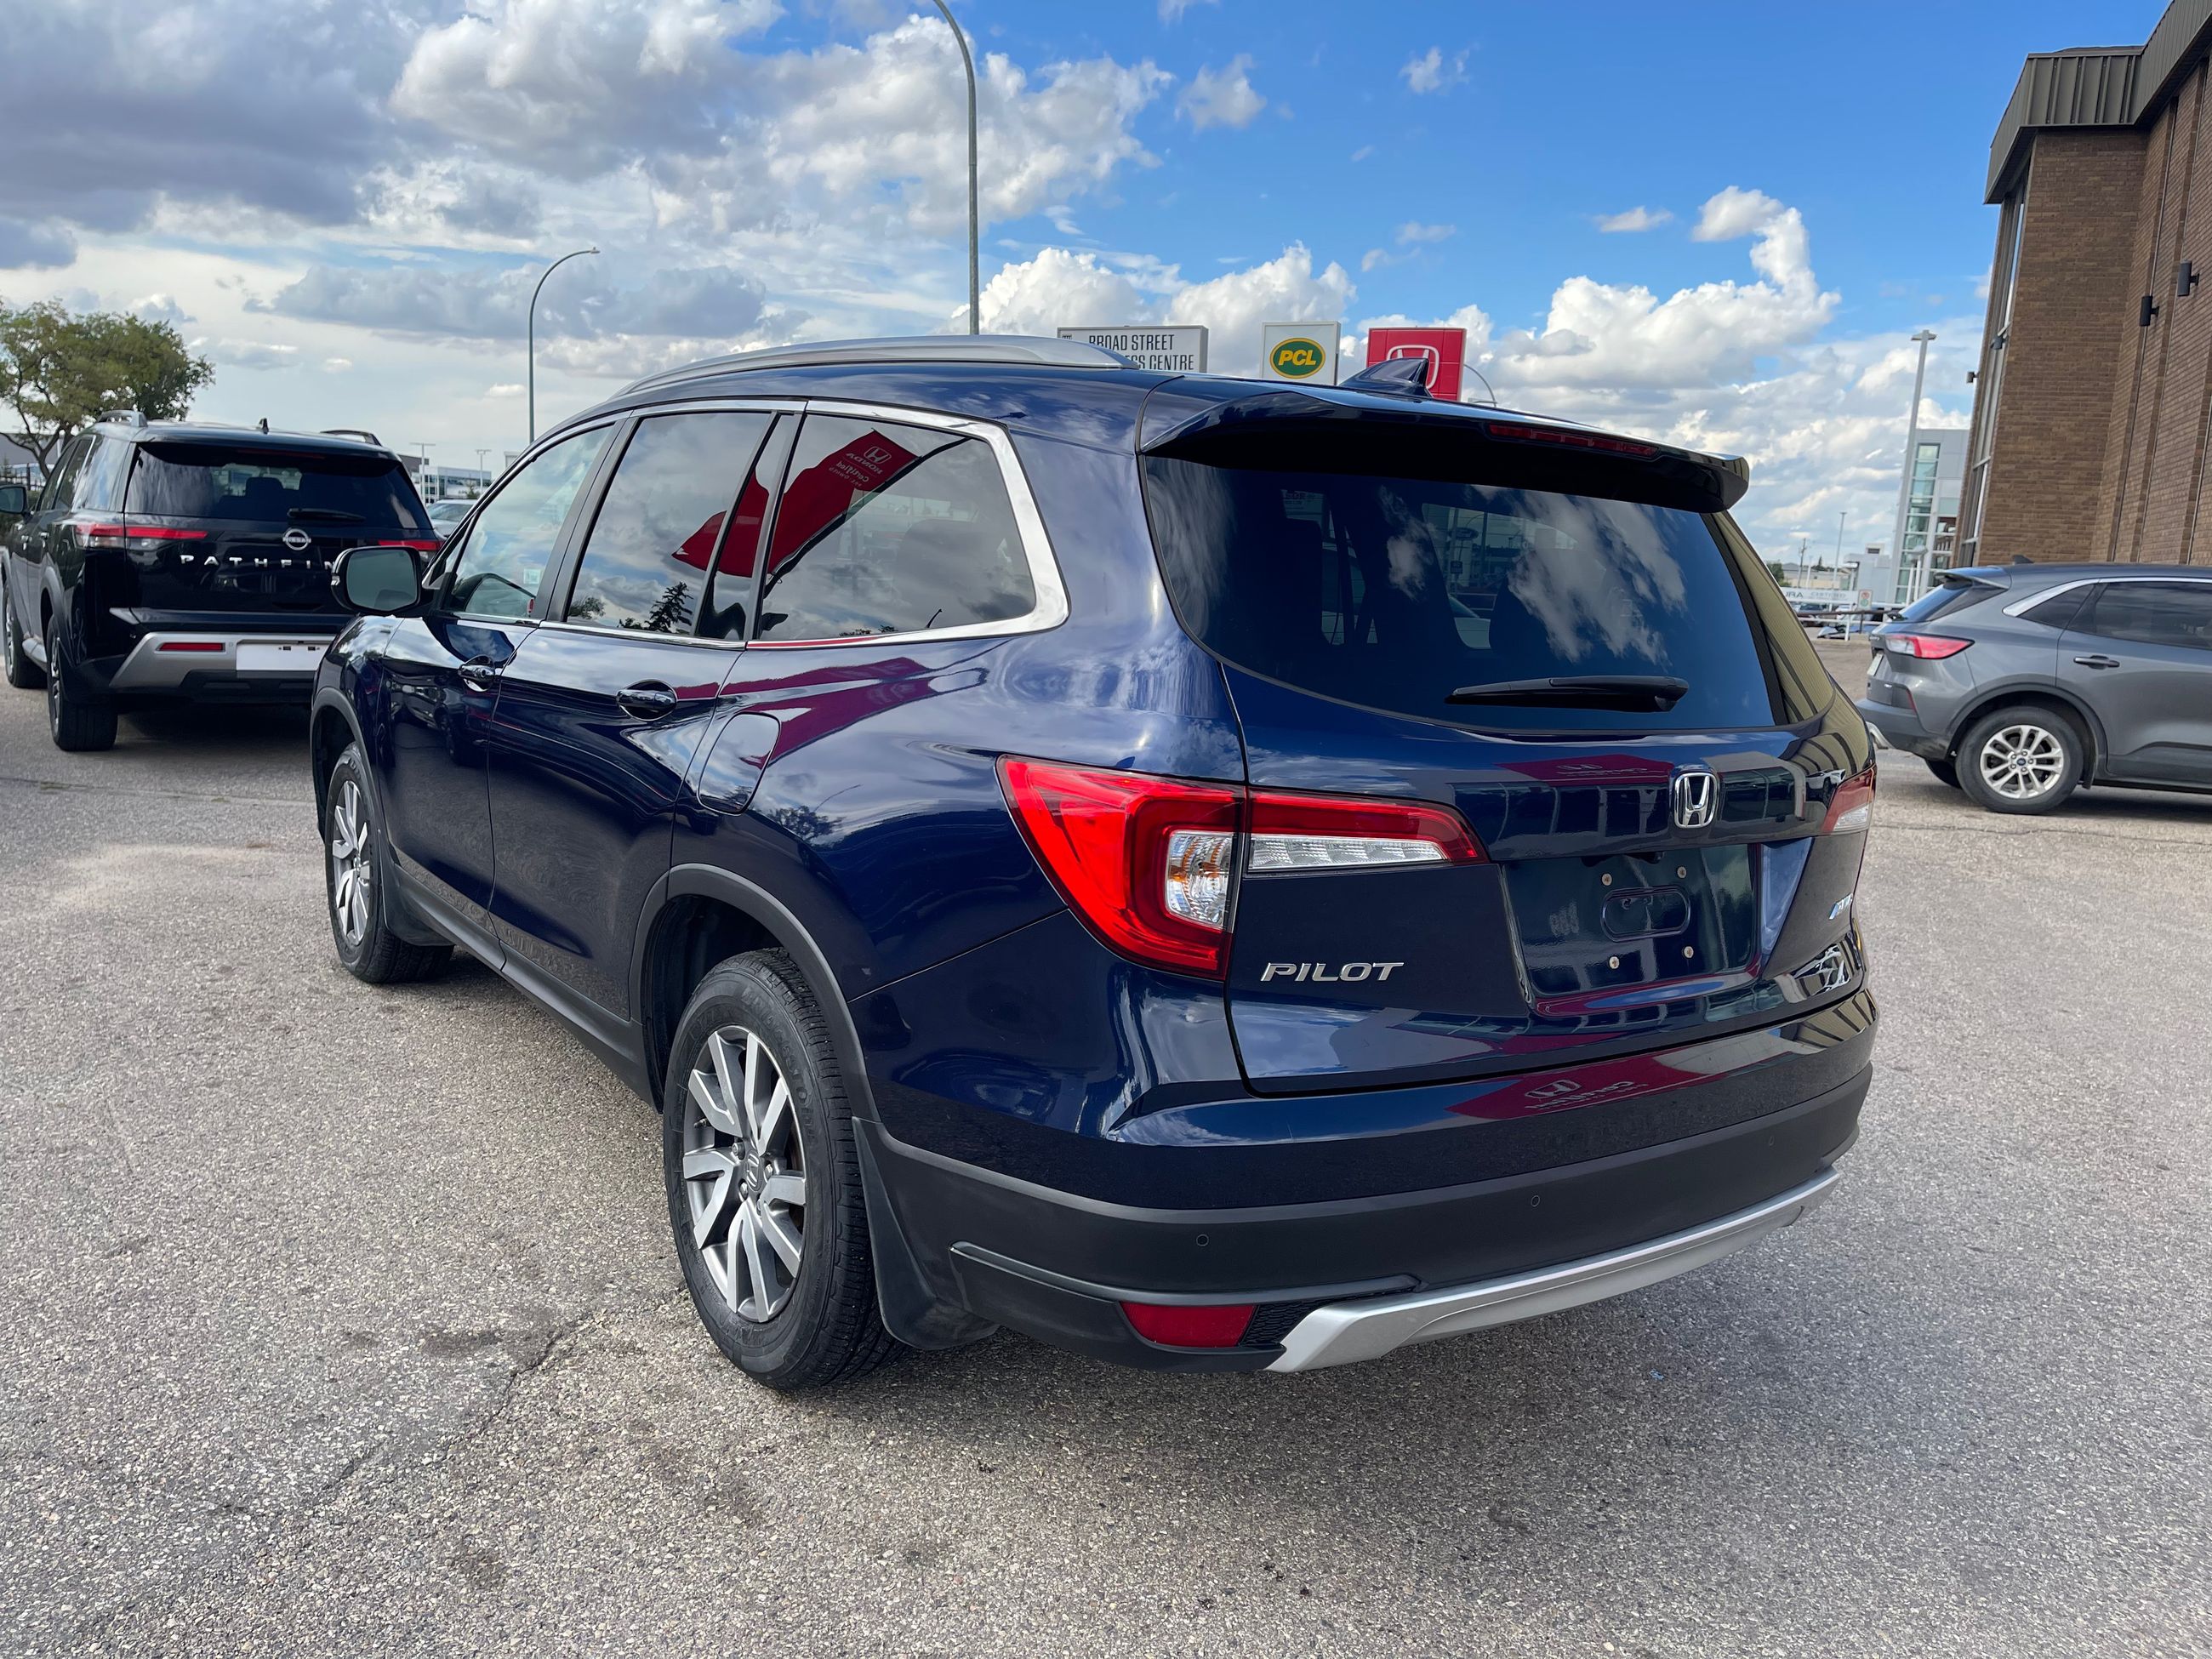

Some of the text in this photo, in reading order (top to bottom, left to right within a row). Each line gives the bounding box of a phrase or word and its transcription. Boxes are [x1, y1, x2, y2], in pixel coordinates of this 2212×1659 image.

[1089, 334, 1175, 351] BROAD STREET
[1149, 354, 1194, 370] CENTRE
[1278, 350, 1316, 366] PCL
[180, 554, 335, 571] PATHFIN
[1260, 961, 1405, 982] PILOT
